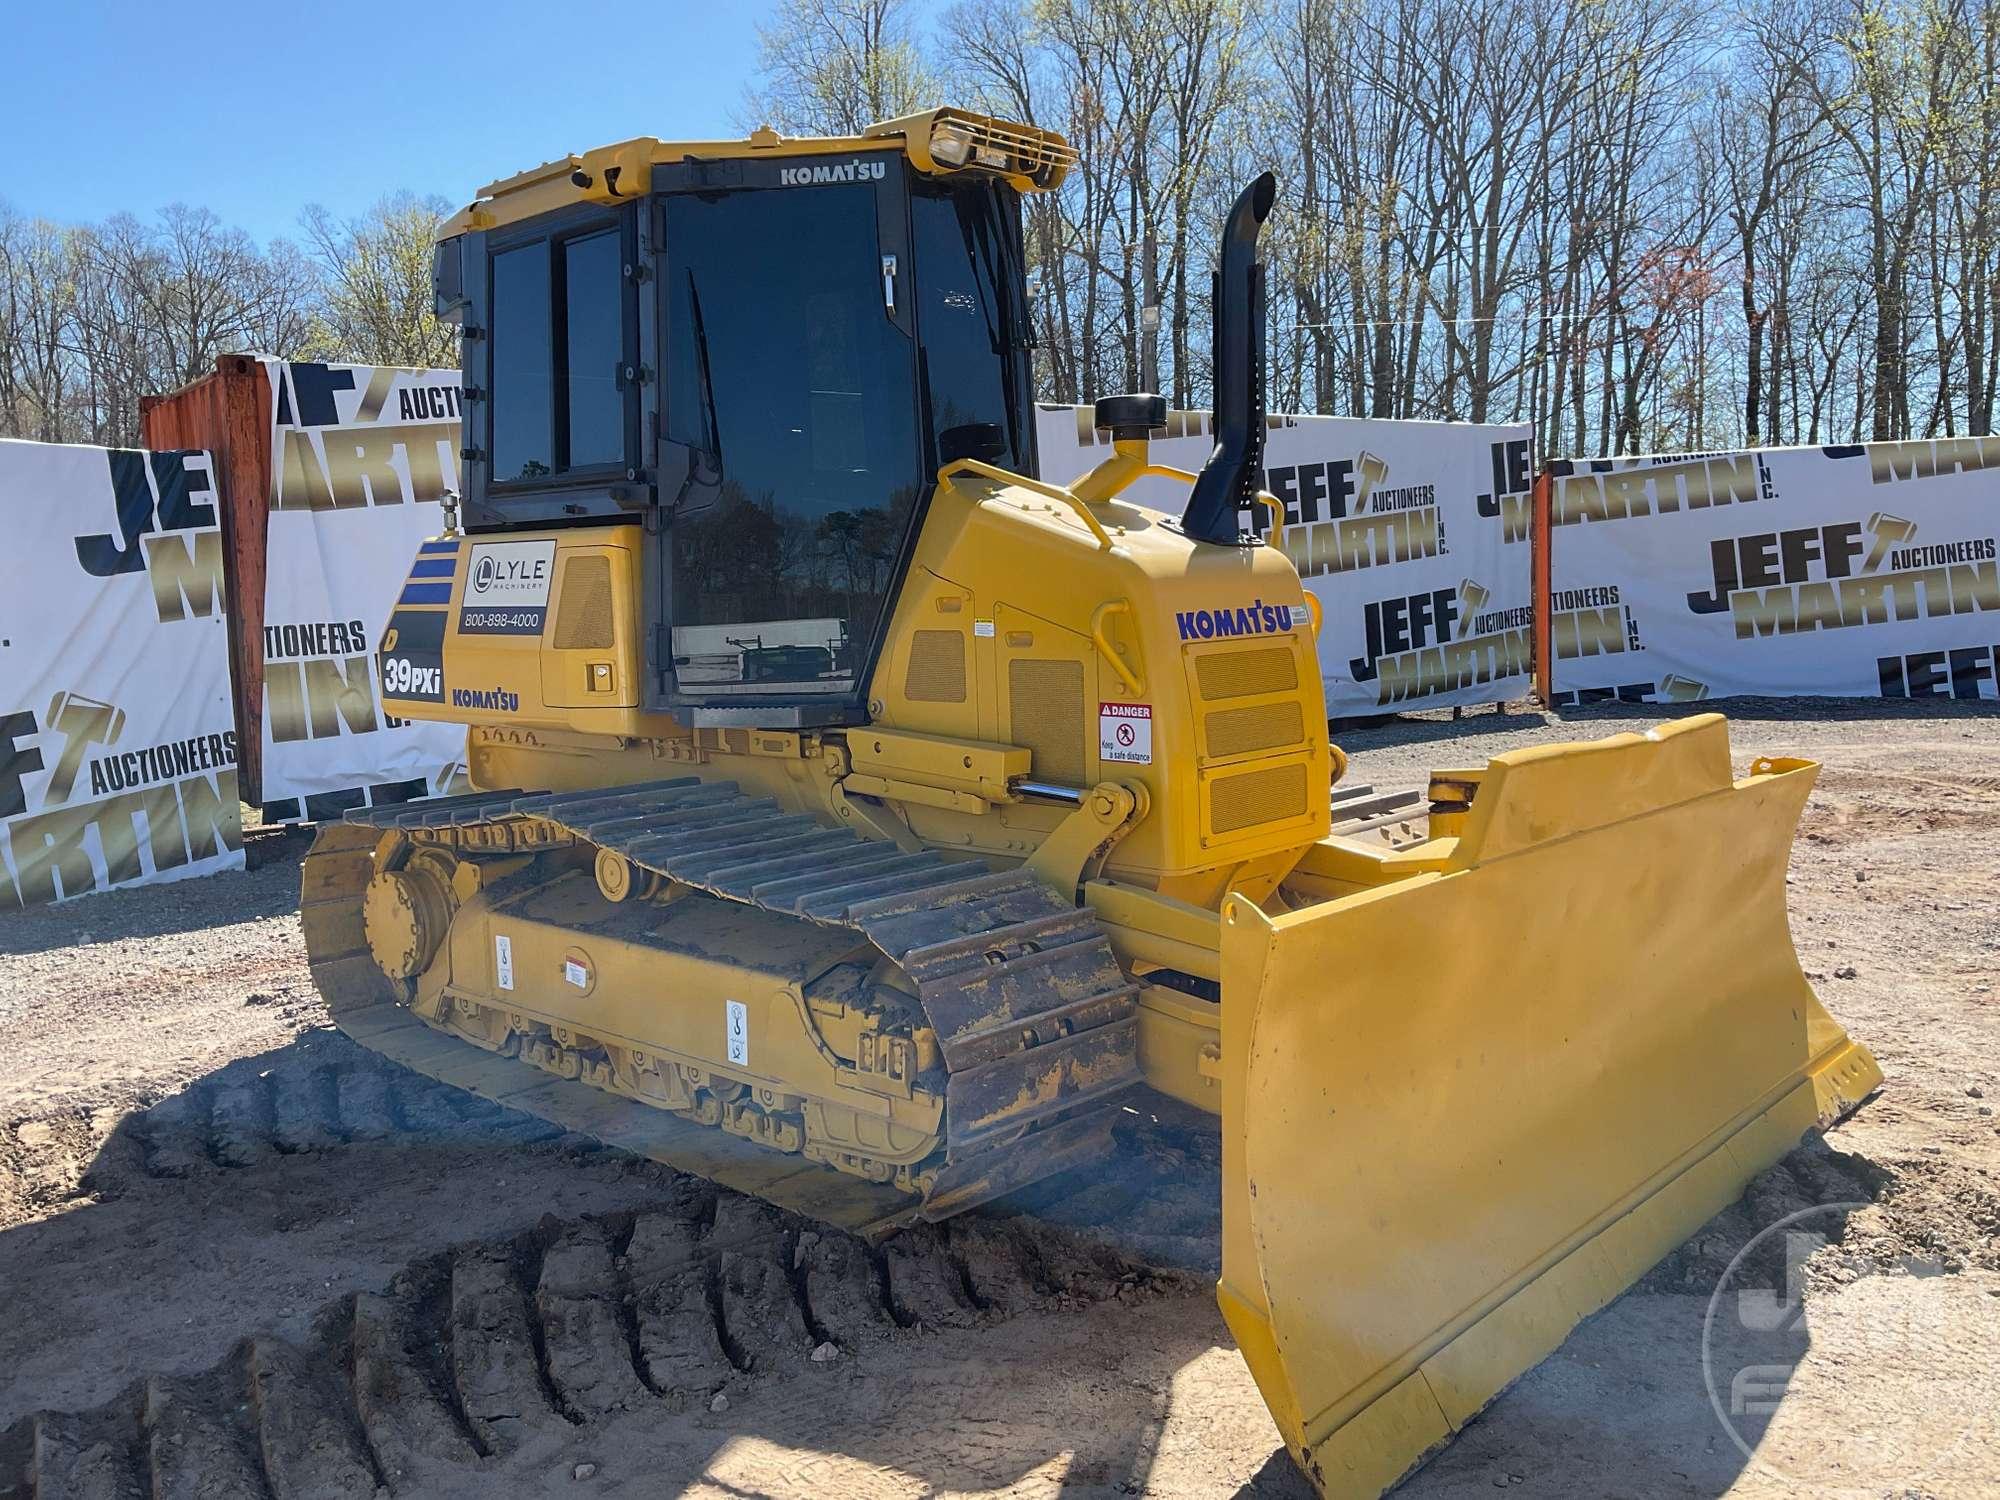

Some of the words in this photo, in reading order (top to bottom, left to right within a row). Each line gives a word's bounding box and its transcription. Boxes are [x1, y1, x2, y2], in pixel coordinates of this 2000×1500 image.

[781, 158, 885, 185] KOMATSU
[1372, 485, 1435, 513] AUCTIONEERS
[1477, 440, 1530, 518] JE
[75, 450, 217, 577] JE
[495, 559, 547, 580] LYLE
[1687, 522, 1865, 616] JEFF
[1891, 538, 1997, 571] AUCTIONEERS
[464, 613, 539, 628] 800-898-4000
[1176, 599, 1293, 640] KOMATSU
[1729, 561, 2000, 644] MARTIN
[1349, 587, 1459, 683] JEFF
[1474, 605, 1532, 637] AUCTIONEERS
[1552, 607, 1626, 660] IN
[384, 658, 441, 695] 39PXi
[1377, 626, 1532, 707] MARTIN
[264, 655, 379, 744] IN
[452, 686, 519, 712] KOMATSU
[1111, 705, 1150, 718] DANGER
[90, 730, 238, 796] AUCTIONEERS
[0, 768, 244, 912] RTIN
